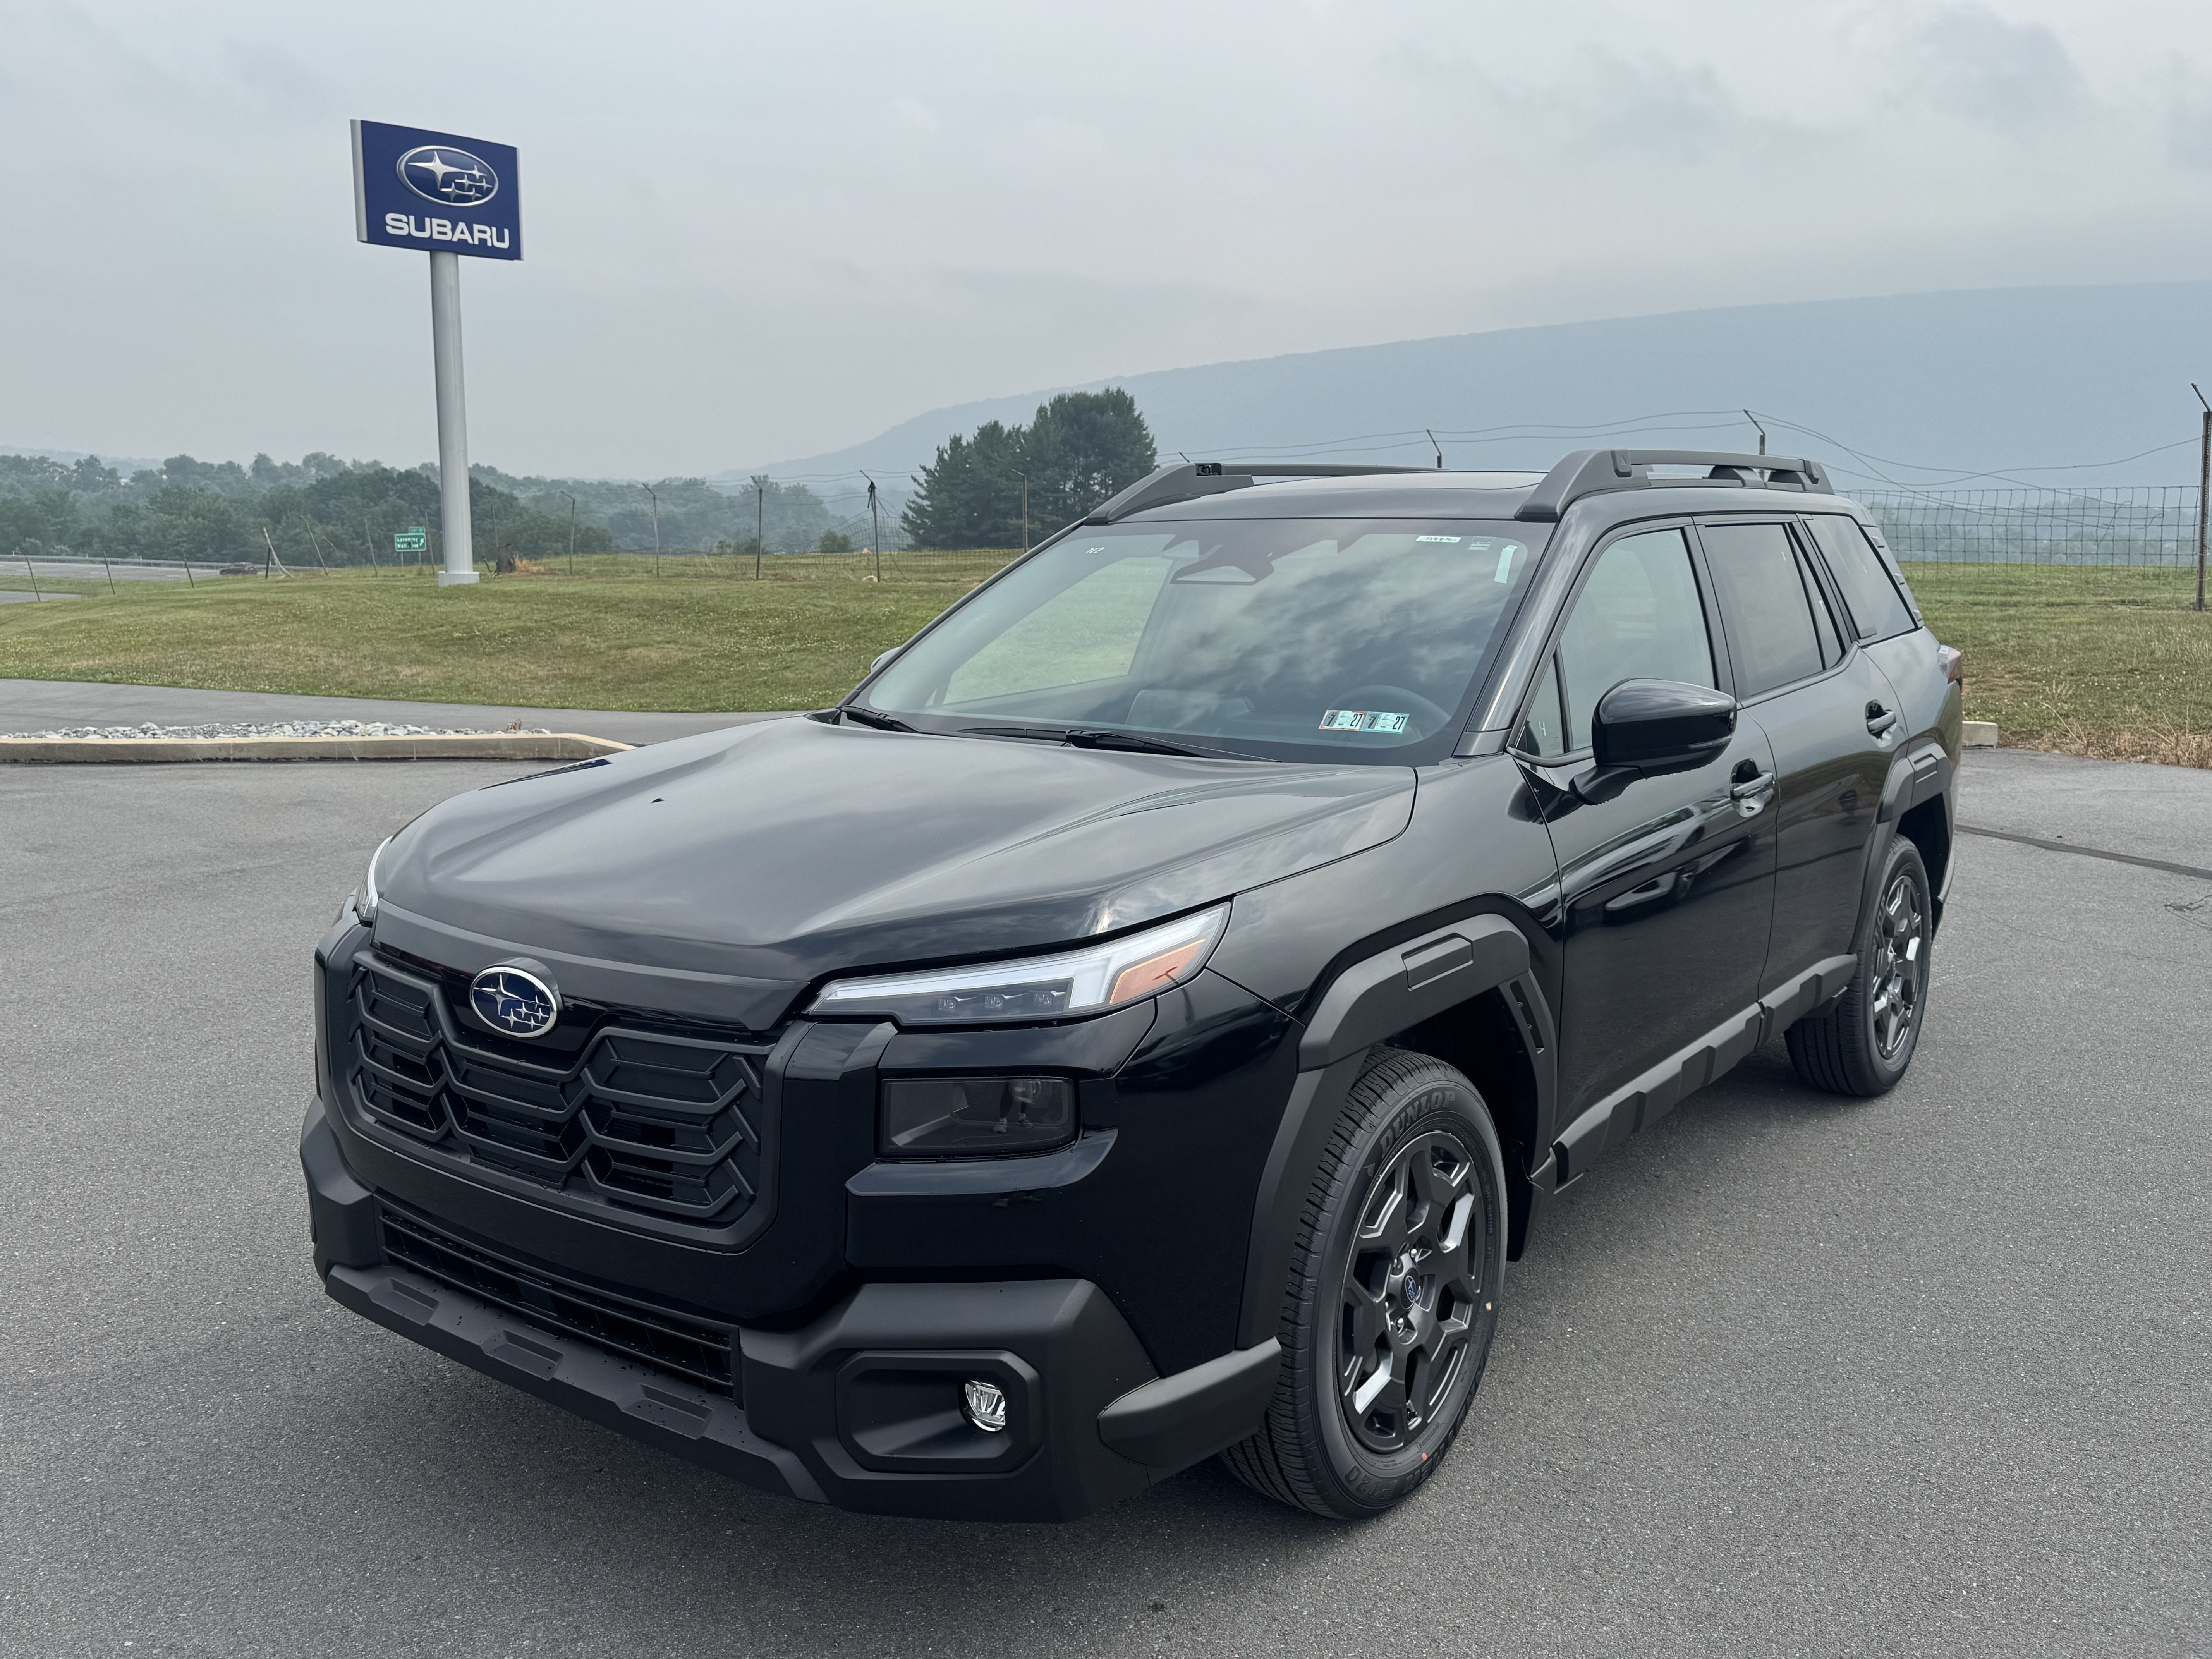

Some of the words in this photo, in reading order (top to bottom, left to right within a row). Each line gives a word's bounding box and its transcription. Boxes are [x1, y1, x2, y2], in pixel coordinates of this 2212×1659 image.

[385, 213, 510, 249] SUBARU
[1326, 714, 1336, 726] 7
[1350, 714, 1363, 728] 27
[1368, 716, 1377, 729] 7
[1392, 716, 1406, 730] 27
[1380, 1091, 1455, 1159] DUNLOP
